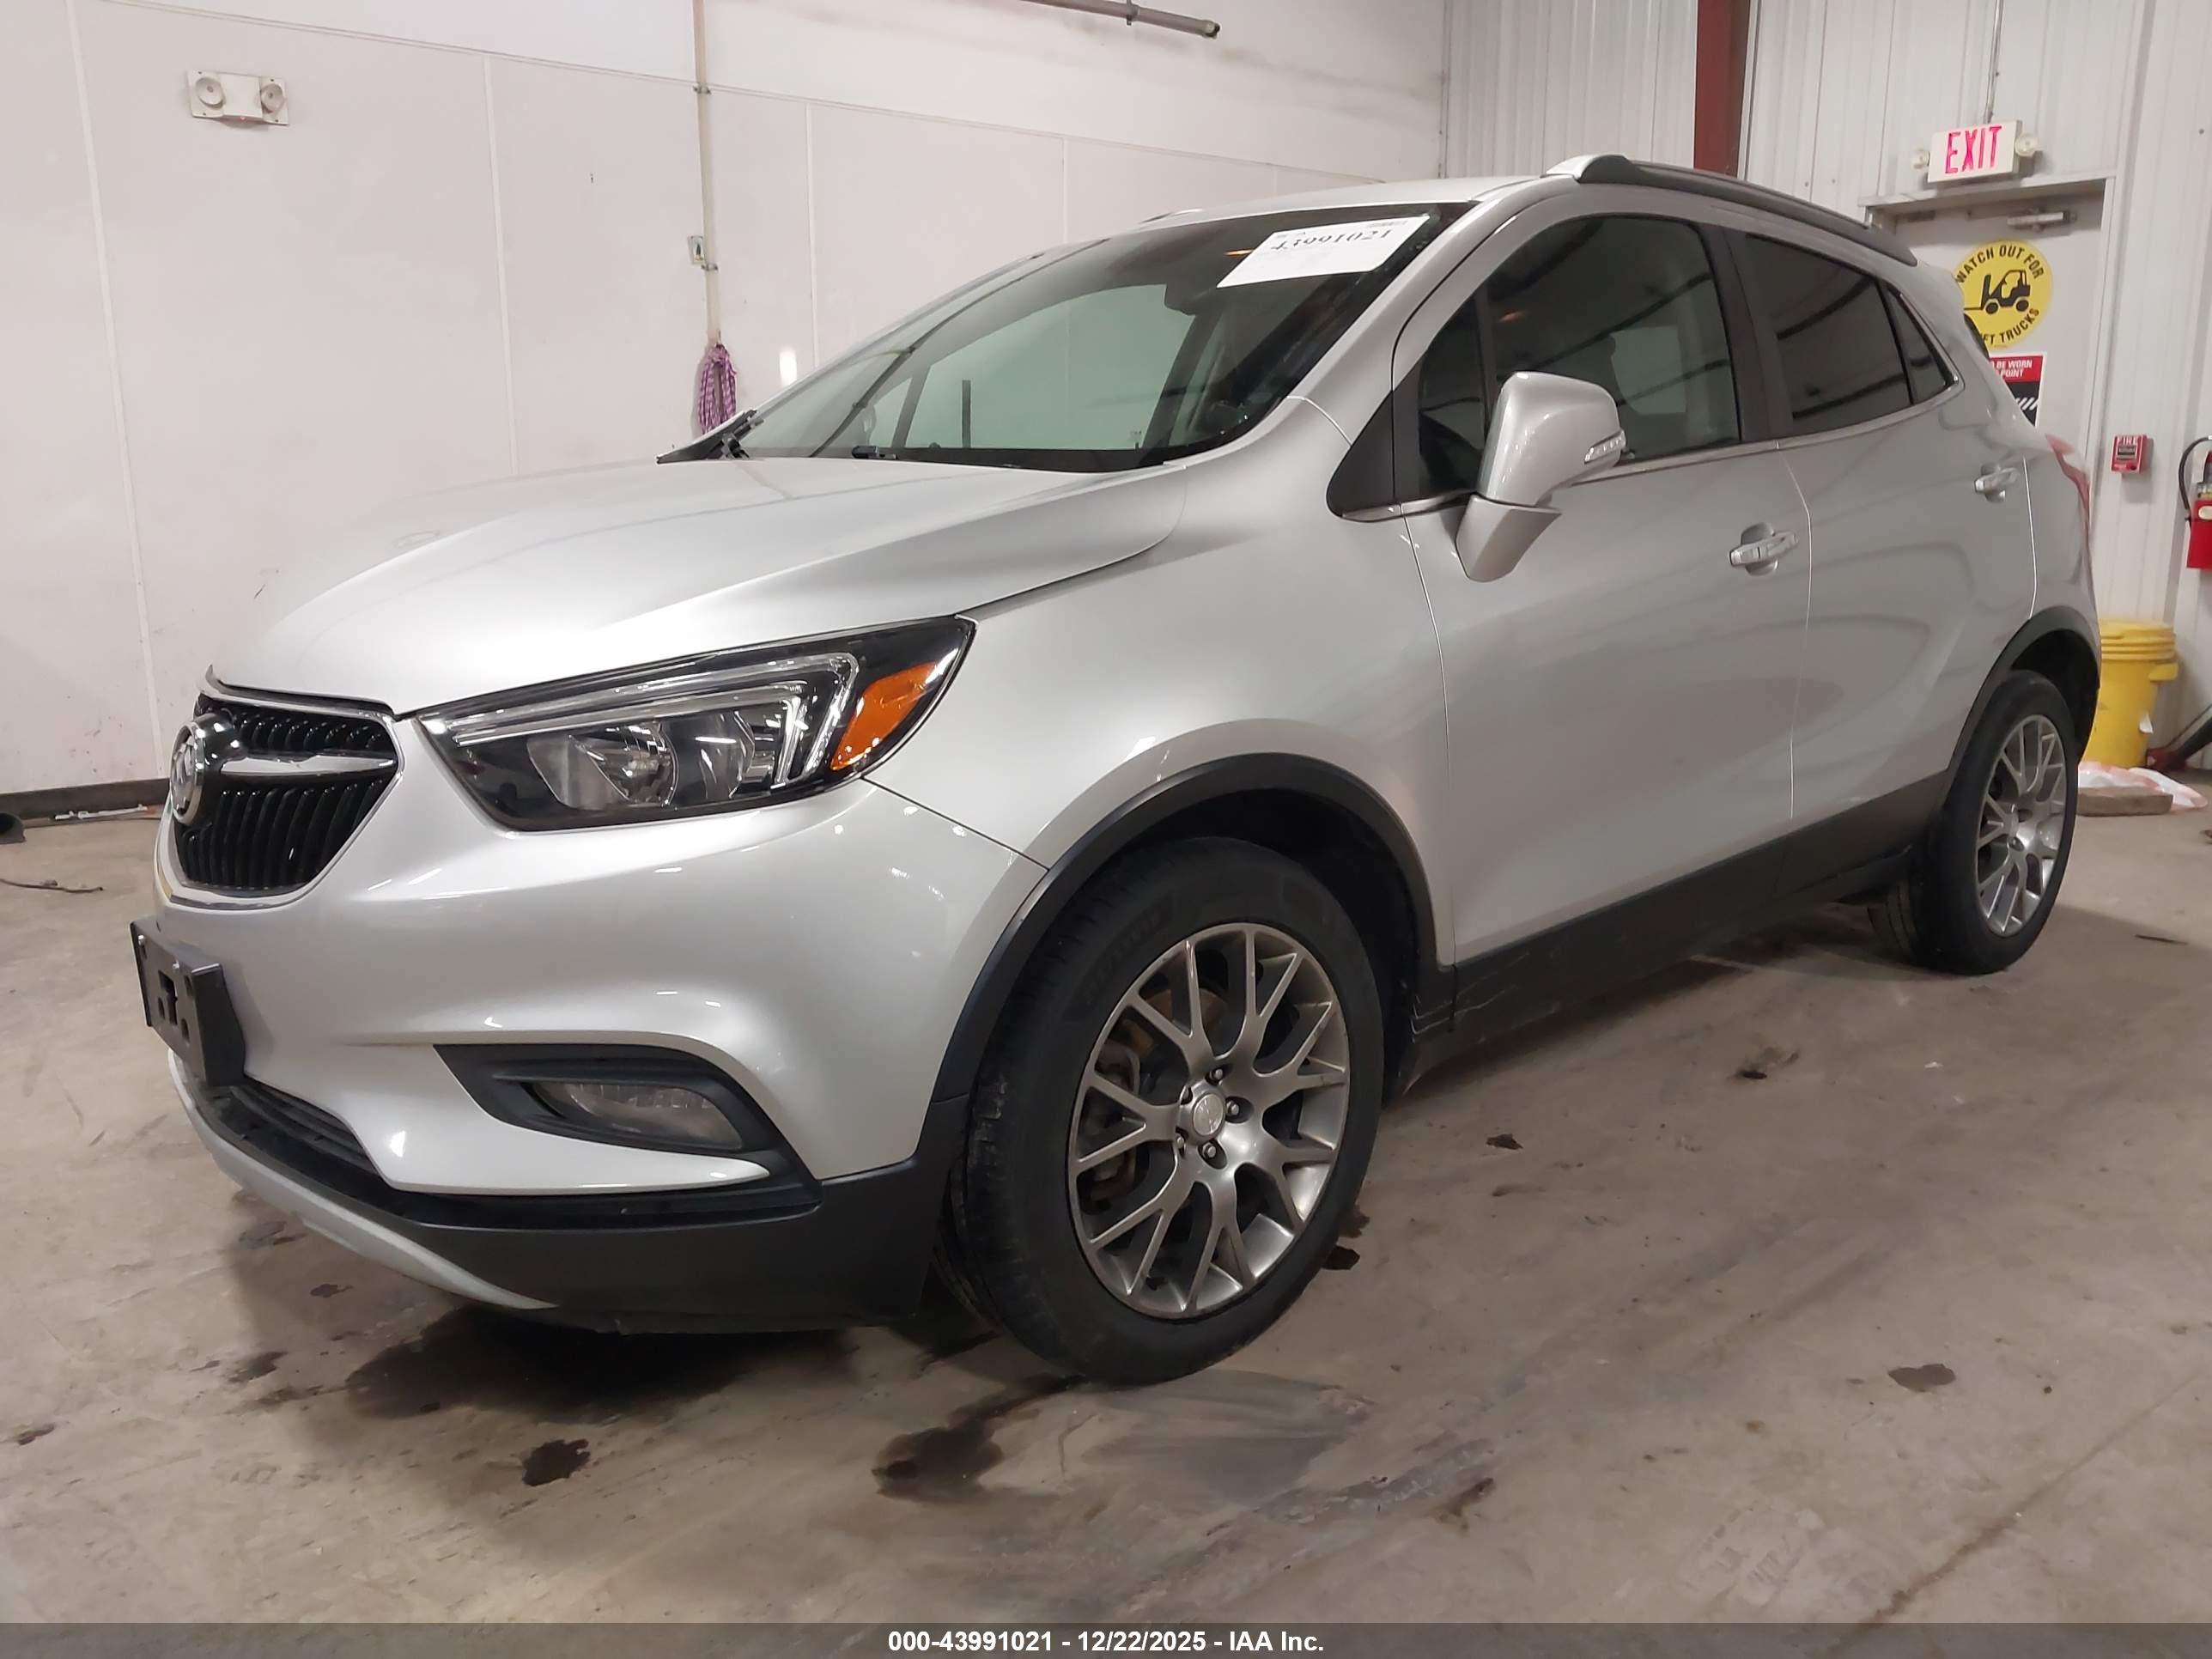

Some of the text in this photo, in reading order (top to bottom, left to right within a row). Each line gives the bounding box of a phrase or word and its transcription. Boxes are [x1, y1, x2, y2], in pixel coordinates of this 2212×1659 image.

[1945, 125, 2002, 173] EXIT
[1955, 245, 2044, 283] WATCH OUT FOR
[1999, 308, 2039, 343] TRUCKS
[2008, 359, 2033, 368] WORN
[2117, 435, 2138, 446] FIRE
